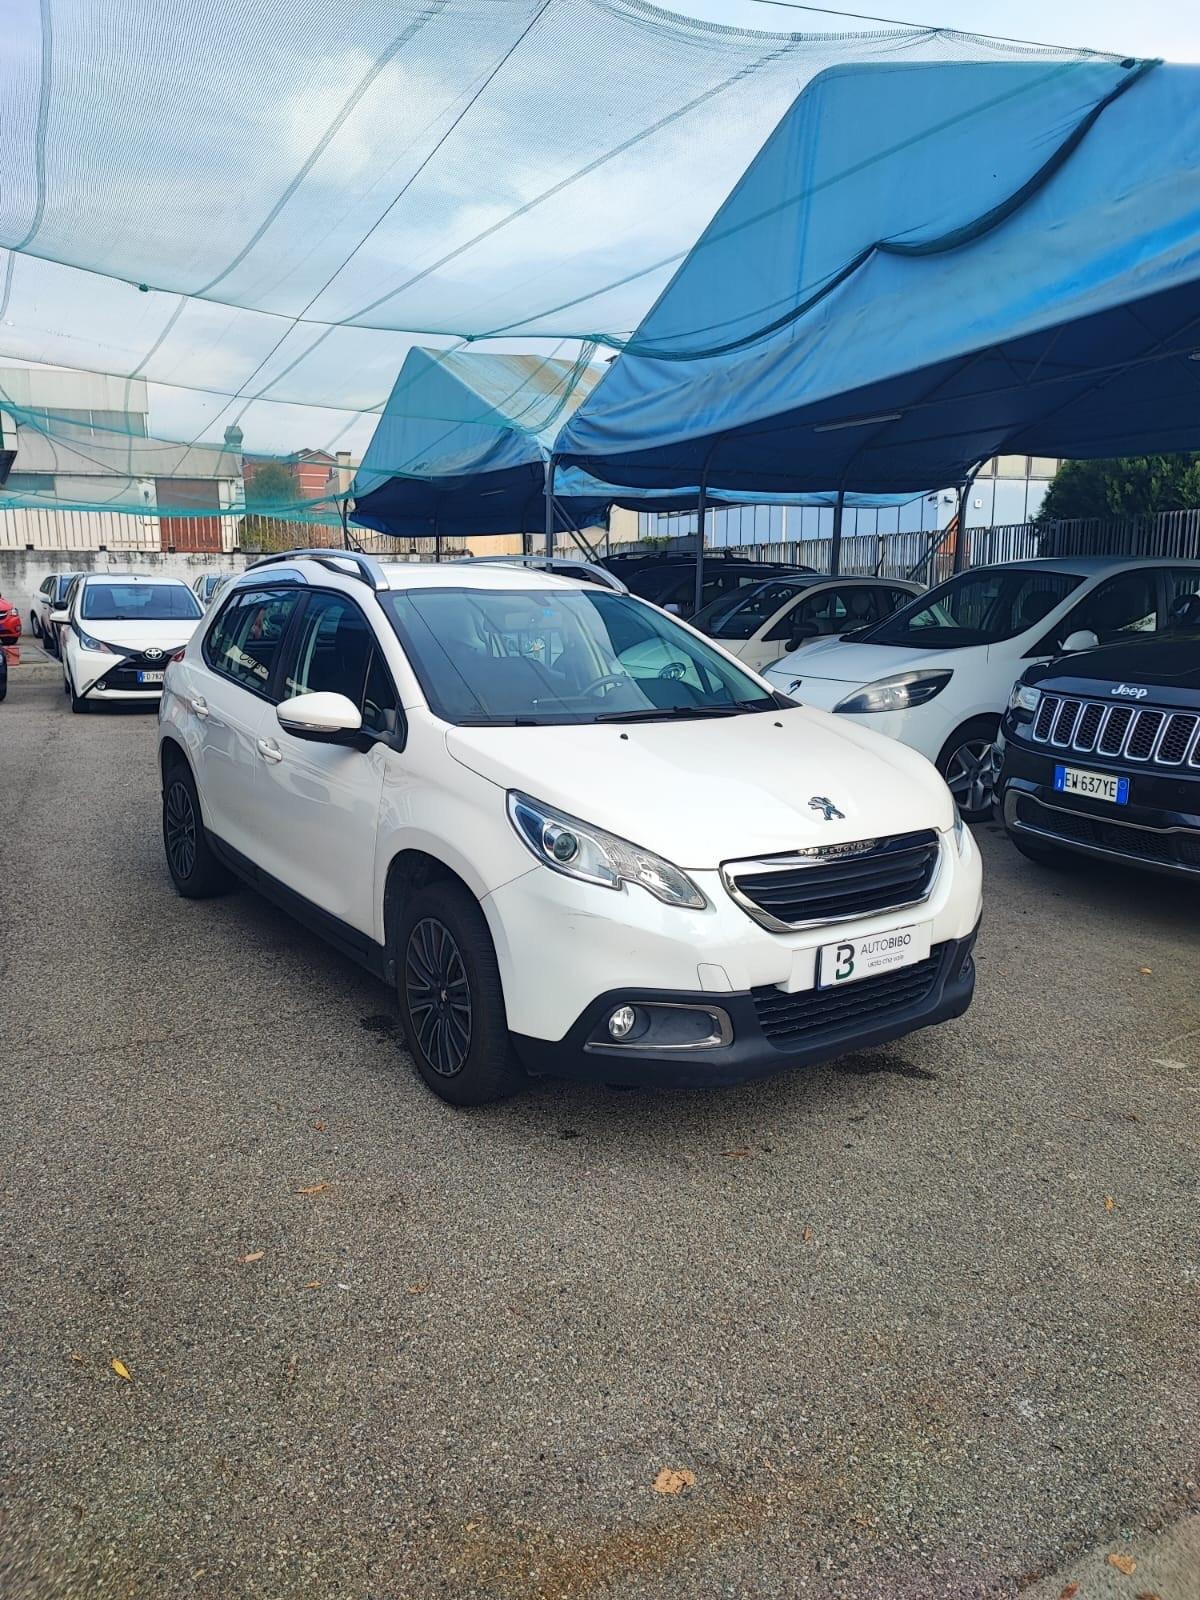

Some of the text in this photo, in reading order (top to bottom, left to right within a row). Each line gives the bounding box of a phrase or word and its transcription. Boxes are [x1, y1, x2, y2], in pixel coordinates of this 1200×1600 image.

[1111, 684, 1148, 699] Jeep
[1065, 772, 1117, 798] EW 637YE
[860, 933, 912, 955] AUTOBIBO
